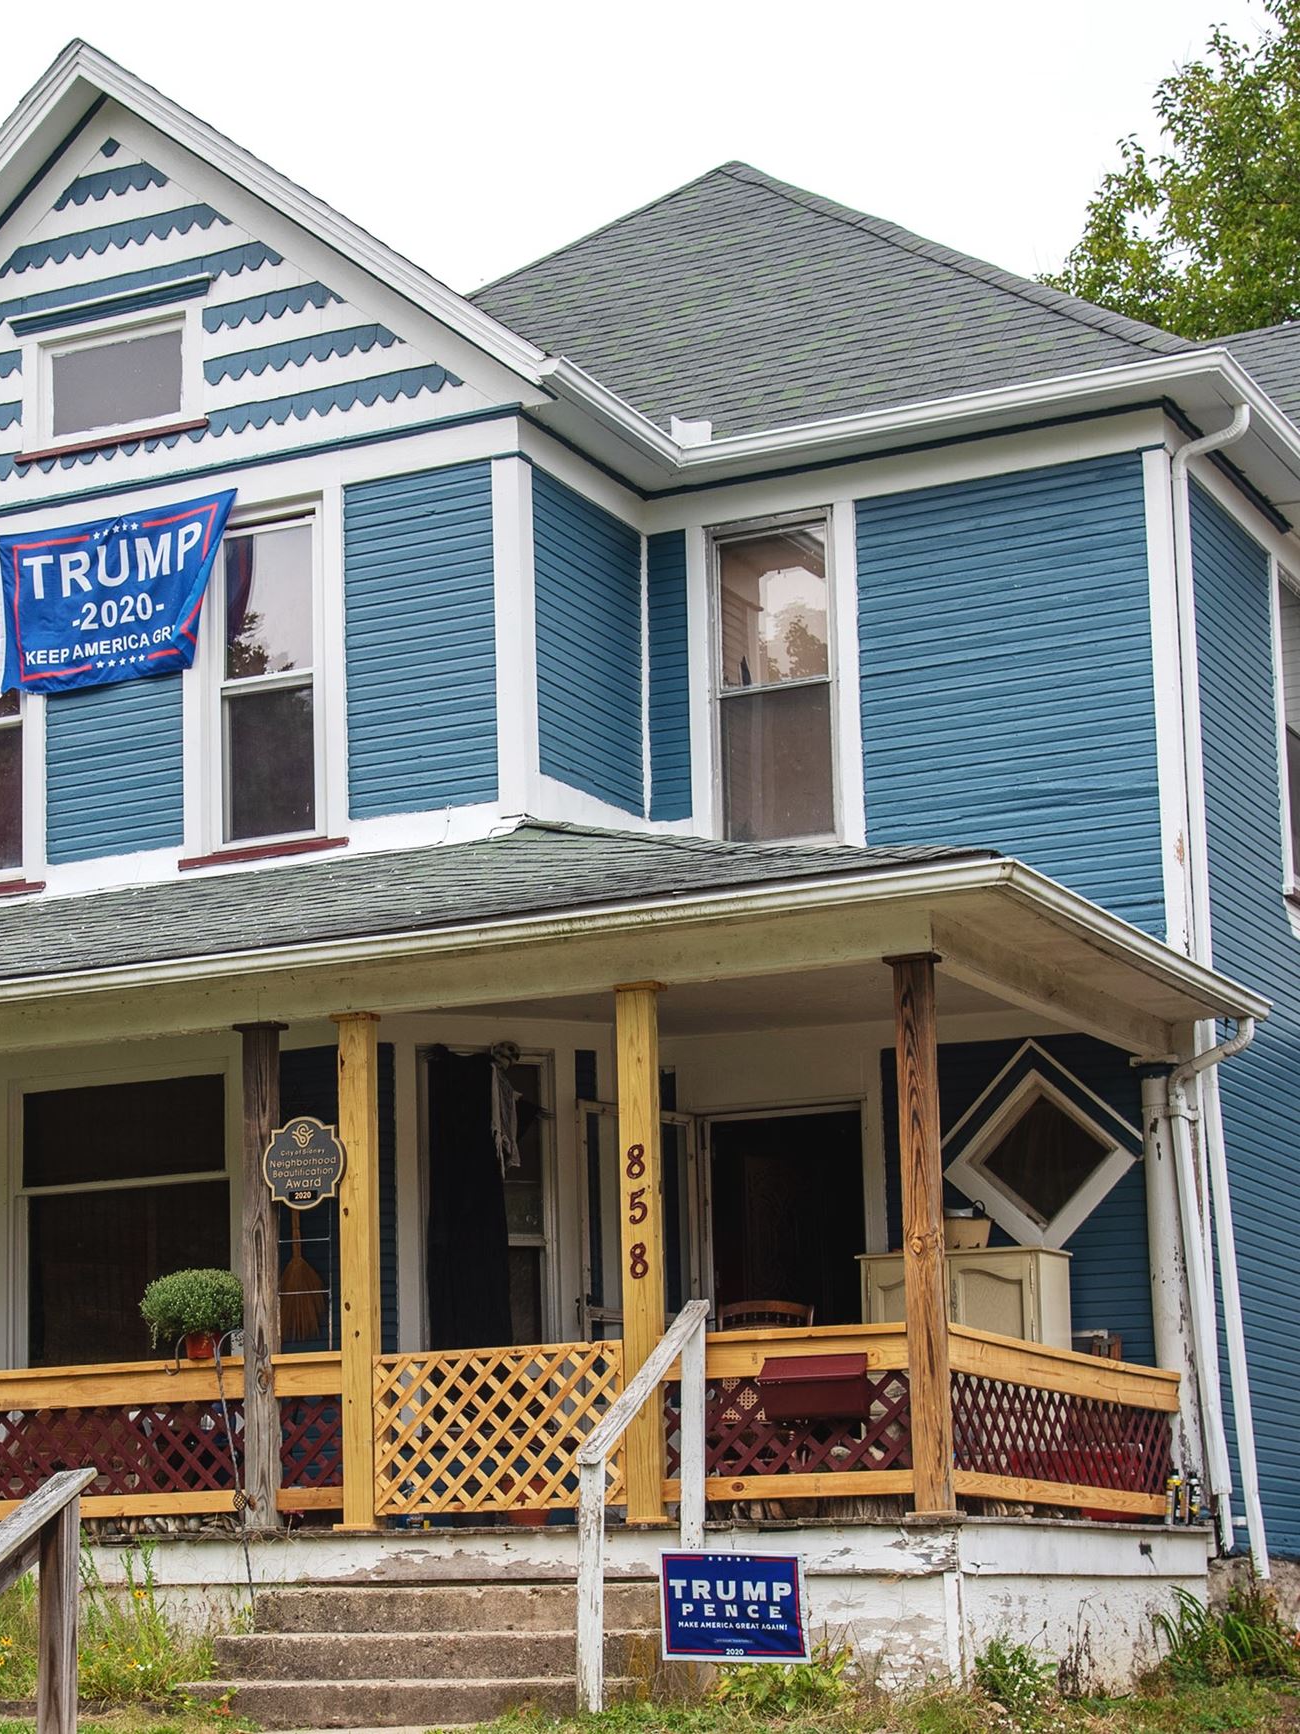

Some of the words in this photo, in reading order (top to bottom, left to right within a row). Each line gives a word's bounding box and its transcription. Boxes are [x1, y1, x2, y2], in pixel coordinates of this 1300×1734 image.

[22, 521, 203, 600] TRUMP
[72, 592, 165, 631] -2020-
[25, 647, 70, 666] KEEP
[73, 632, 150, 660] AMERICA
[270, 1155, 337, 1169] Neighborhood
[272, 1167, 333, 1178] Beautification
[285, 1177, 321, 1189] Award
[294, 1191, 312, 1200] 2020
[669, 1579, 792, 1602] TRUMP
[682, 1603, 783, 1619] PENCE
[678, 1621, 699, 1629] MAKE
[700, 1621, 734, 1629] AMERICA
[735, 1622, 760, 1630] GREAT
[761, 1623, 788, 1631] AGAIN!
[725, 1648, 745, 1656] 2020
